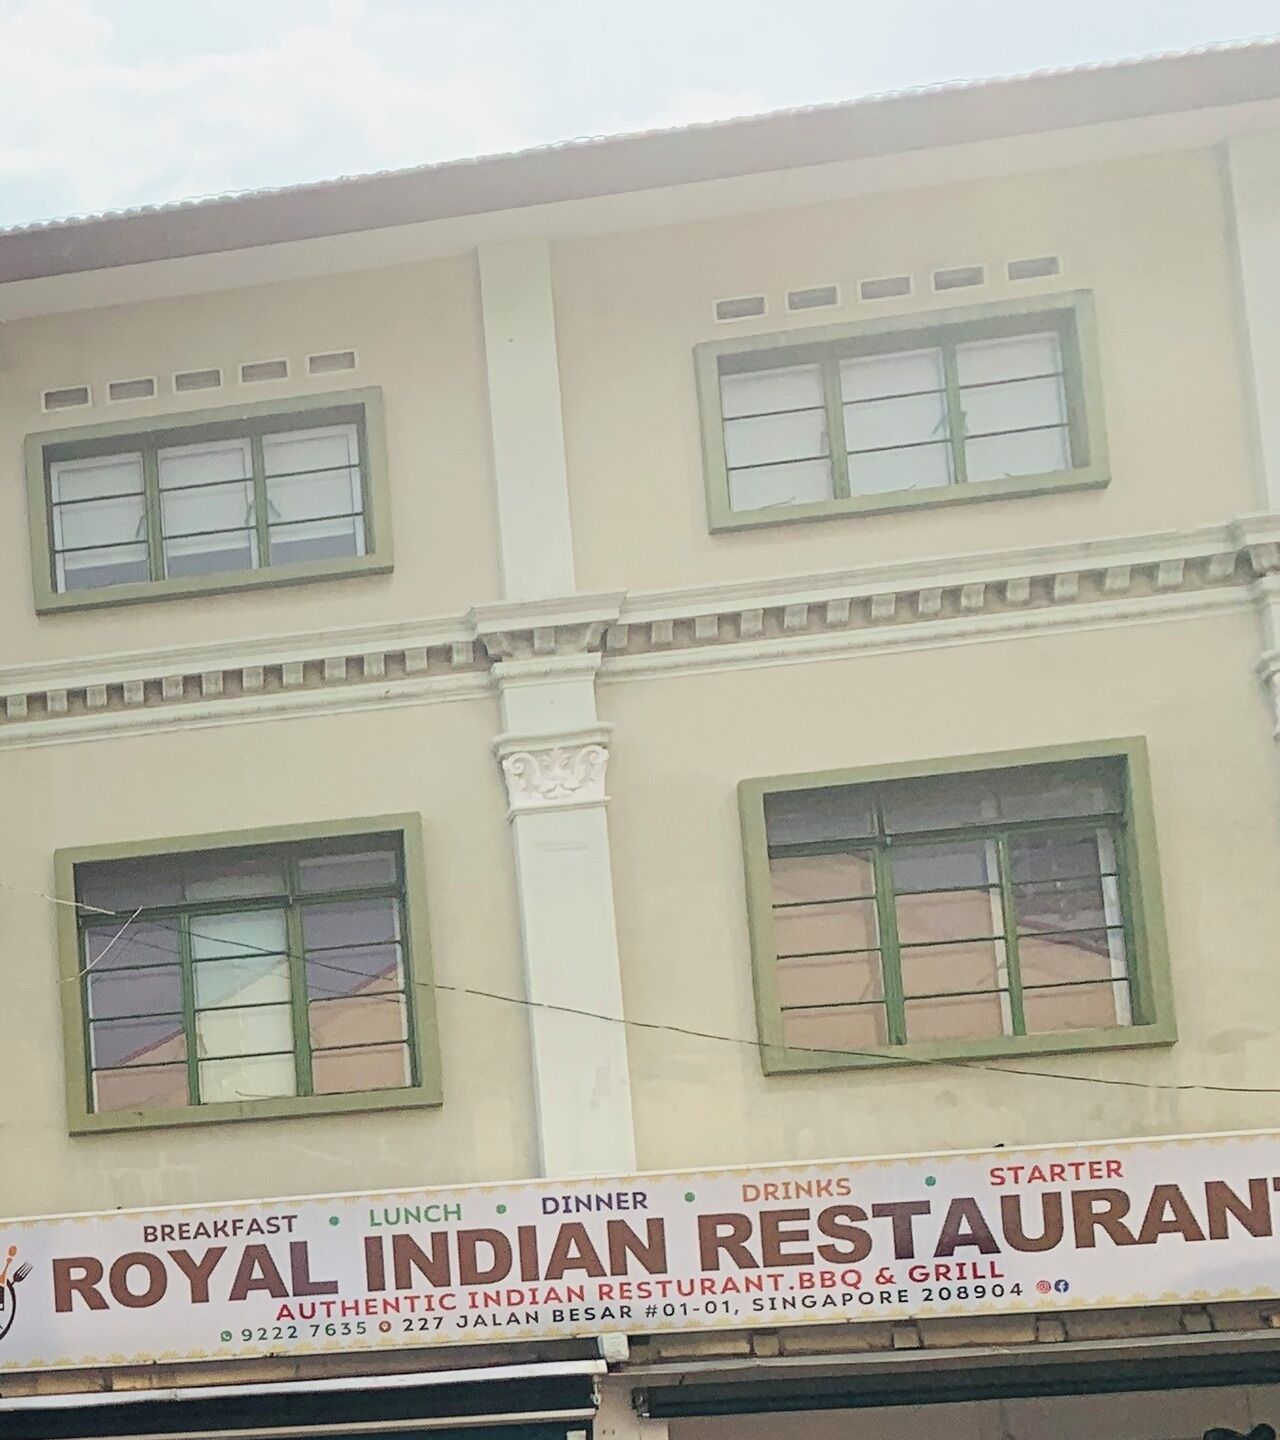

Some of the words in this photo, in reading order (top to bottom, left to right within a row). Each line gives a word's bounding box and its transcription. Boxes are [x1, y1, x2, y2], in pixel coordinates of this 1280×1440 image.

[143, 1214, 299, 1243] BREAKFAST
[368, 1202, 462, 1228] LUNCH
[541, 1191, 648, 1216] DINNER
[742, 1178, 852, 1204] DRINKS
[989, 1159, 1124, 1187] STARTER
[51, 1240, 339, 1314] ROYAL
[363, 1216, 669, 1292] INDIAN
[697, 1177, 1280, 1273] RESTAURAN
[240, 1323, 299, 1342] 9222
[309, 1319, 368, 1338] 7635
[402, 1316, 444, 1333] 227
[456, 1310, 540, 1329] JALAN
[552, 1303, 634, 1324] BESAR
[644, 1299, 740, 1319] #01-01,
[752, 1288, 910, 1313] SINGAPORE
[922, 1282, 1023, 1303] 208904
[276, 1292, 458, 1322] AUTHENTIC
[467, 1284, 585, 1309] INDIAN
[874, 1266, 898, 1286] &
[908, 1261, 1006, 1283] GRILL
